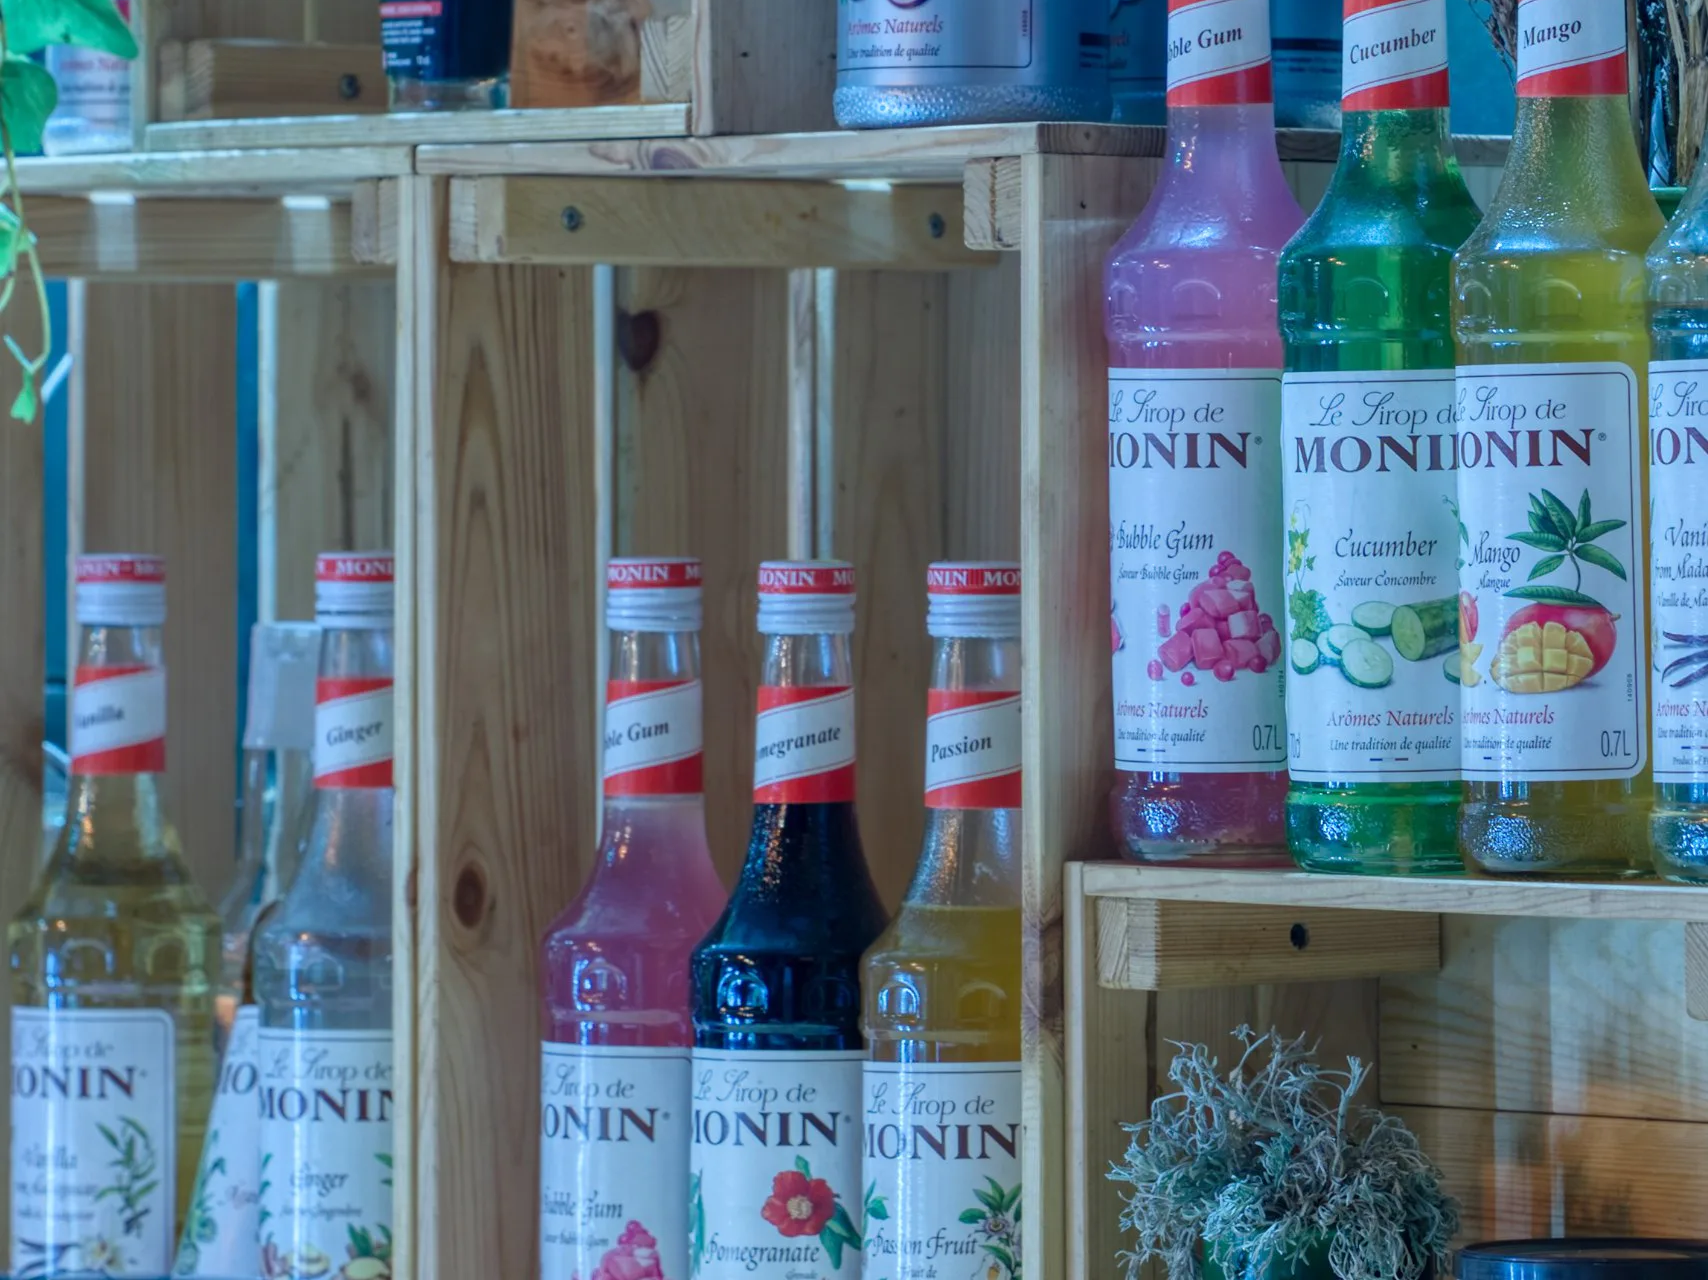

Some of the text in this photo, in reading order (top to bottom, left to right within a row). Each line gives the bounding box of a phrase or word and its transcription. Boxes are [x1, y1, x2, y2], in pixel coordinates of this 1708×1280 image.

[884, 14, 944, 35] Naturels
[1197, 27, 1243, 49] Gum
[1523, 18, 1581, 50] Mango
[894, 43, 905, 57] de
[906, 43, 941, 61] qualité
[1349, 26, 1436, 65] Cucumber
[1126, 388, 1185, 432] Sirop
[1193, 402, 1224, 423] de
[1309, 392, 1346, 427] Le
[1352, 391, 1428, 434] Sirop
[1469, 385, 1527, 430] Sirop
[1535, 399, 1566, 420] de
[1294, 434, 1459, 473] MONI
[1457, 428, 1596, 469] ONIN
[1117, 519, 1214, 559] Bubble Gum
[1335, 528, 1438, 558] Cucumber
[1468, 531, 1521, 573] Mango
[1140, 563, 1171, 580] Bubble
[1172, 564, 1199, 585] Gum
[1333, 570, 1438, 590] Saveur Concombre
[1476, 569, 1511, 593] Mangue
[1149, 699, 1208, 718] Naturels
[1326, 705, 1454, 727] Arômes Naturels
[1494, 704, 1555, 725] Naturels
[326, 719, 384, 748] Ginger
[627, 721, 669, 742] Gum
[1170, 729, 1206, 747] qualité
[1252, 724, 1282, 752] 0.7L
[1329, 735, 1452, 754] Une tradition de qualité
[1516, 736, 1552, 754] qualité
[1600, 729, 1631, 757] 0.7L
[932, 734, 993, 764] Passion
[12, 1065, 136, 1101] ONIN
[605, 1078, 635, 1100] de
[716, 1068, 778, 1112] Sirop
[785, 1082, 816, 1103] de
[867, 1081, 994, 1125] Le Sirop de
[705, 1232, 820, 1271] Pomegranate
[926, 1227, 978, 1260] Fruit
